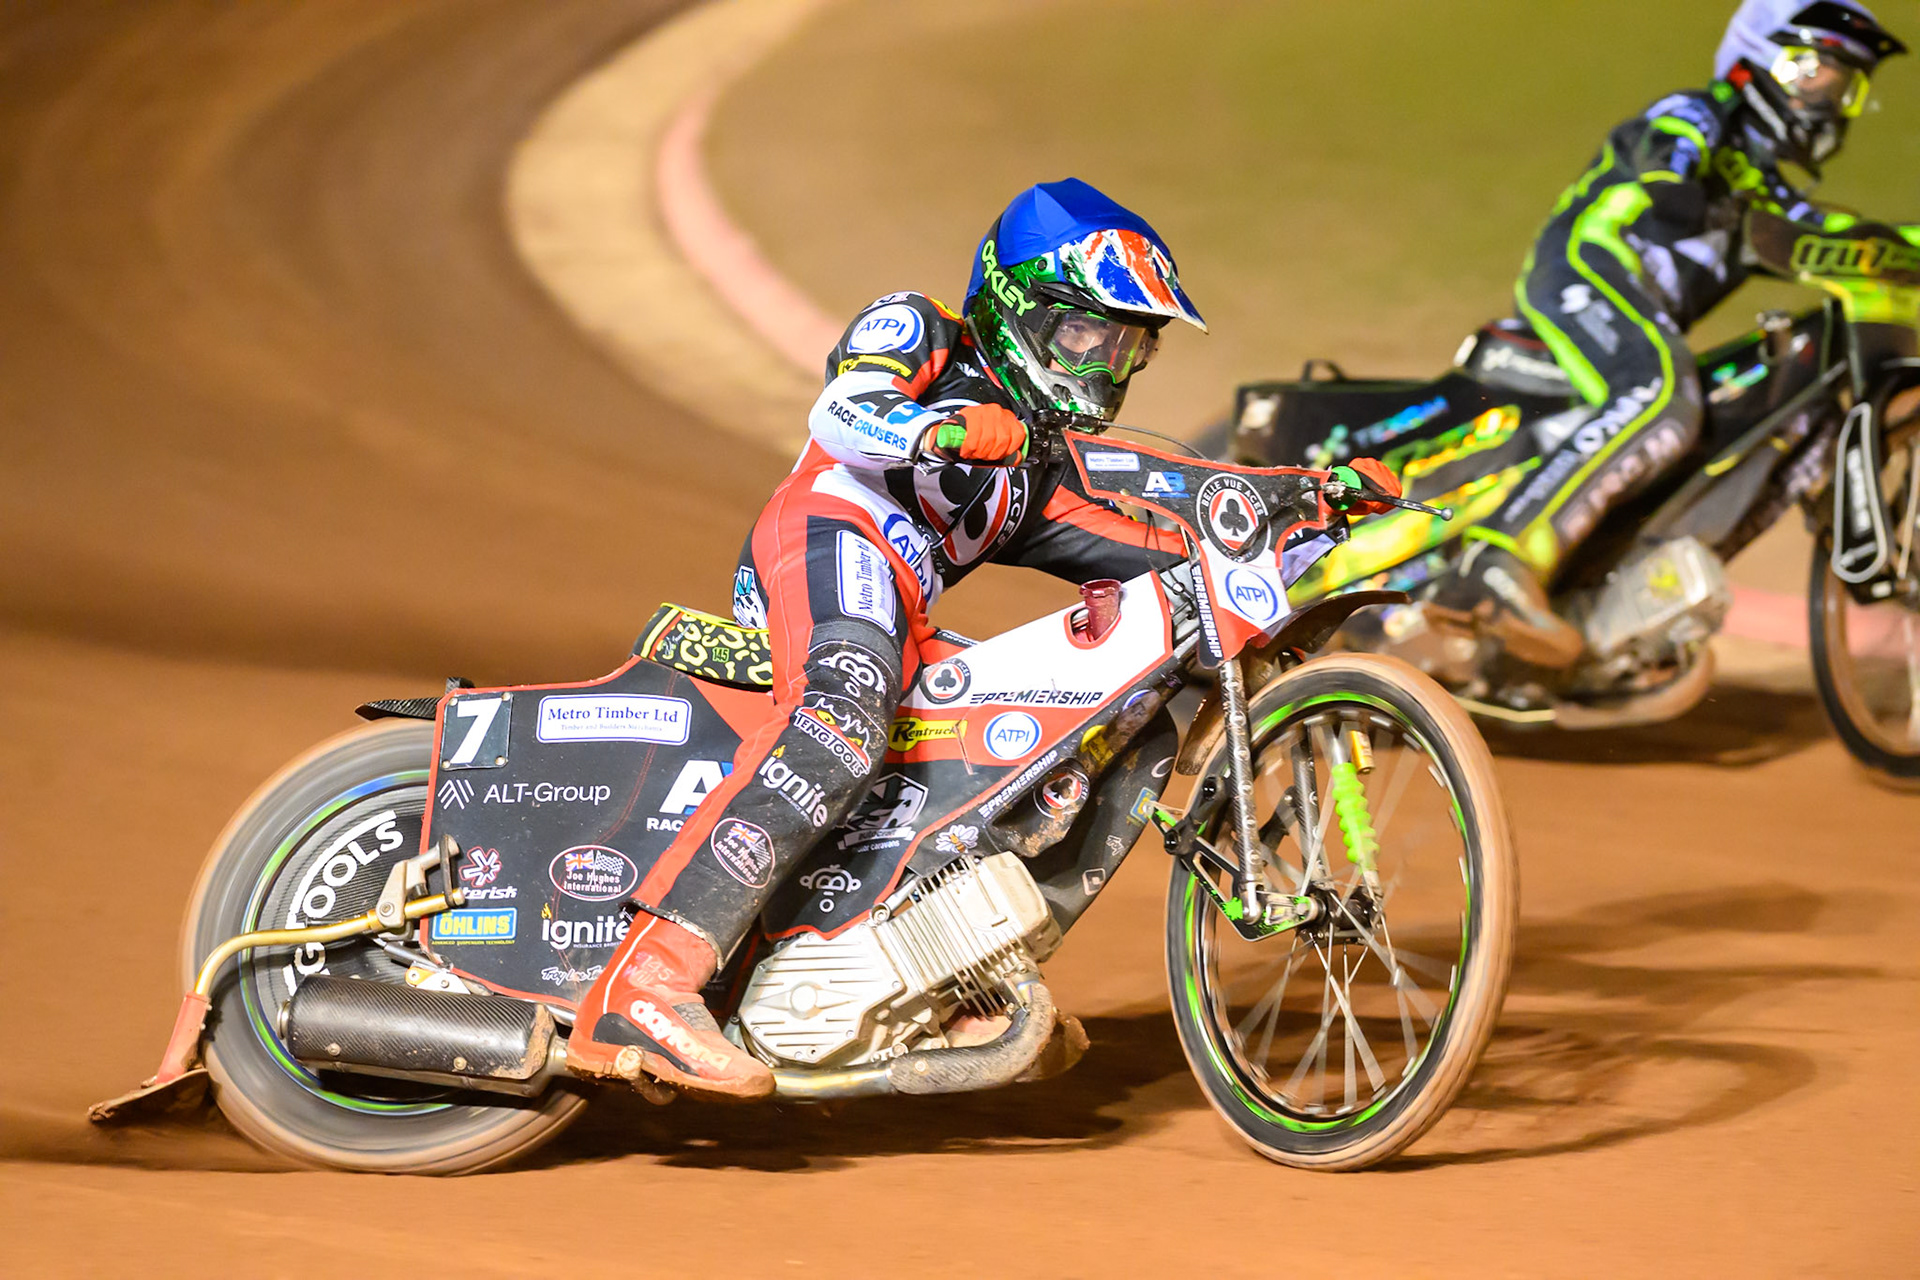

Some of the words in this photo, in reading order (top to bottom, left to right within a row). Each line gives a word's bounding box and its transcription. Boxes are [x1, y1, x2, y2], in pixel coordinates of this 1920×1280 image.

[981, 240, 1037, 316] OAKLEY
[856, 318, 906, 337] ATPI
[828, 401, 857, 427] RACE
[854, 419, 908, 451] CRUSERS
[1201, 480, 1221, 508] BELLE
[1223, 478, 1243, 491] VUE
[1245, 489, 1265, 517] ACES
[1235, 585, 1268, 604] ATPI
[713, 648, 730, 663] 145
[548, 708, 591, 721] Metro
[595, 706, 650, 719] Timber
[654, 708, 678, 723] Ltd
[450, 697, 502, 765] 7
[892, 721, 957, 743] Rentruck
[994, 728, 1030, 743] ATPI
[483, 781, 611, 806] ALT-Group
[759, 749, 828, 828] ignite
[646, 817, 685, 832] RAC
[723, 835, 739, 850] Joe
[566, 870, 583, 882] Joe
[586, 871, 621, 884] Hughes
[564, 881, 622, 894] International
[439, 909, 511, 935] ÖHLINS
[541, 906, 630, 951] ignite
